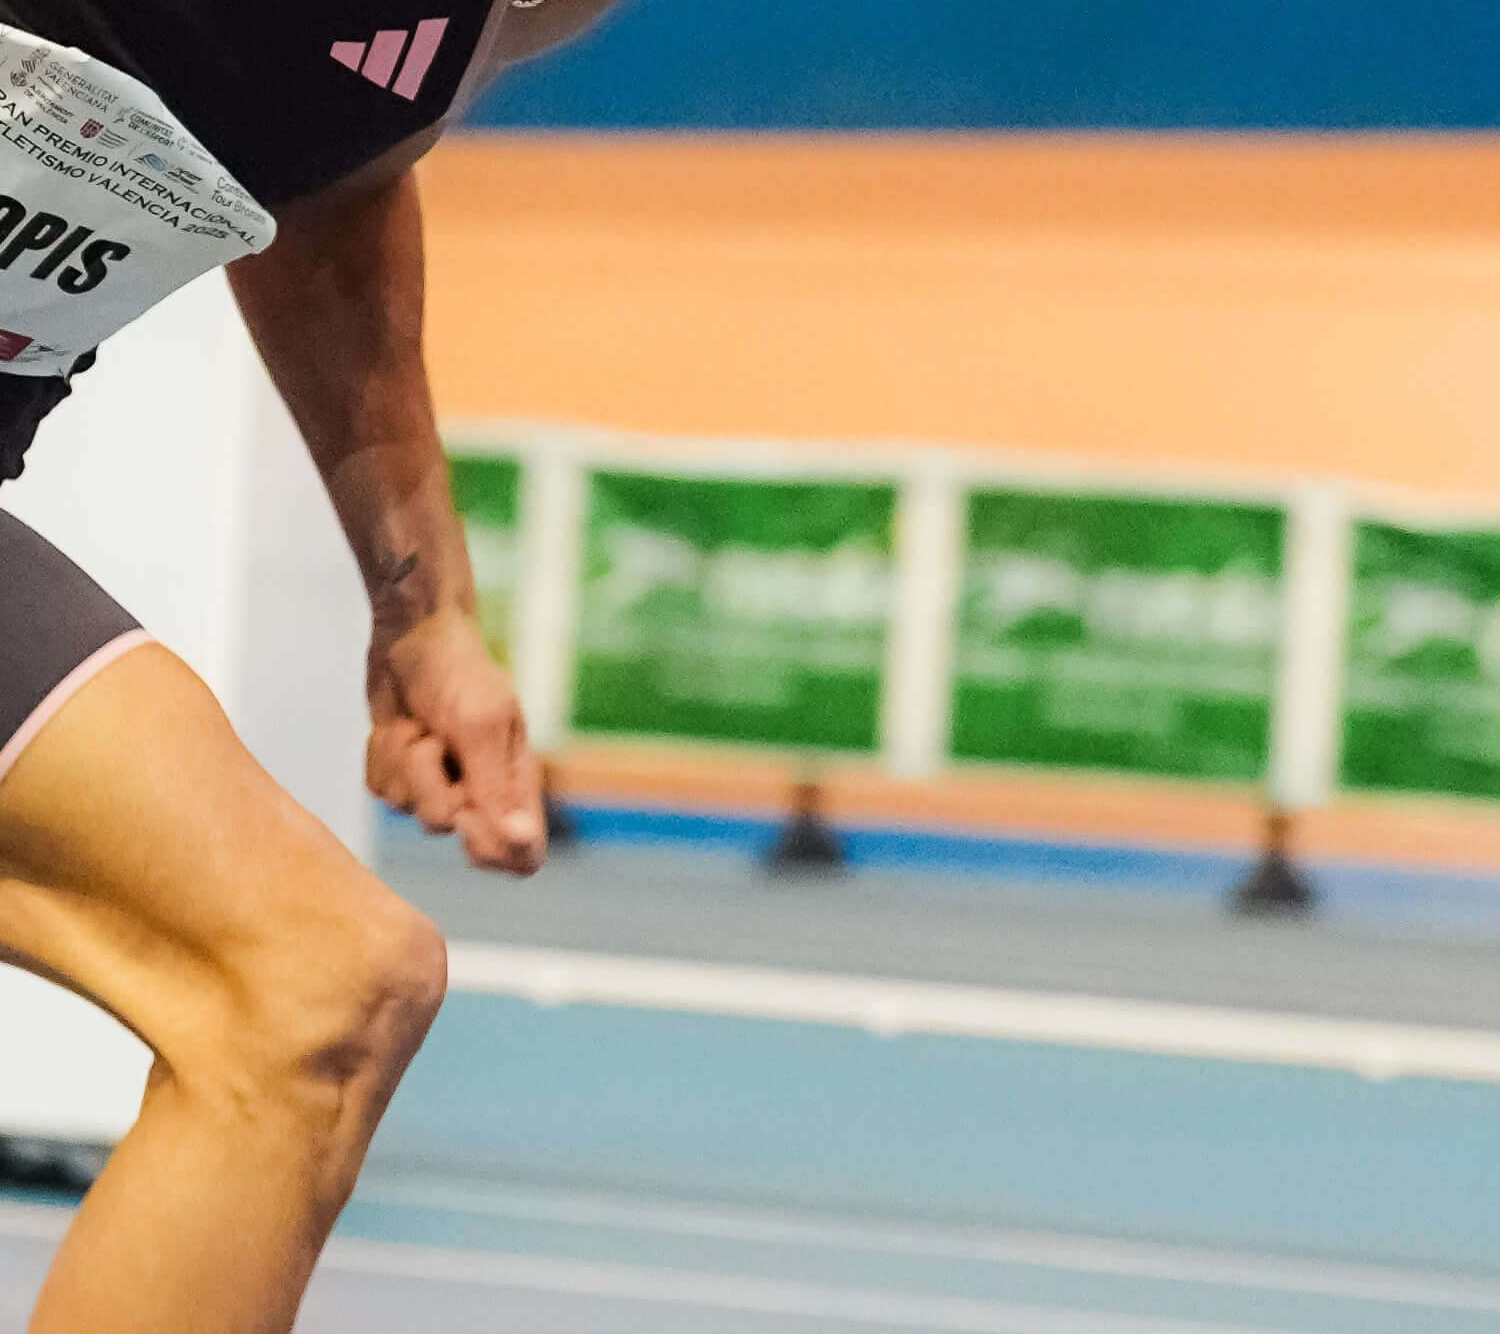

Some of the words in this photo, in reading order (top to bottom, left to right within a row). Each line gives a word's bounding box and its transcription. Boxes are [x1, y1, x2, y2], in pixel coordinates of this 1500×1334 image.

[33, 123, 109, 168] PREMIO
[109, 160, 256, 248] INTERNACIONAL
[88, 172, 181, 229] VALENCIA
[181, 222, 231, 240] 2025
